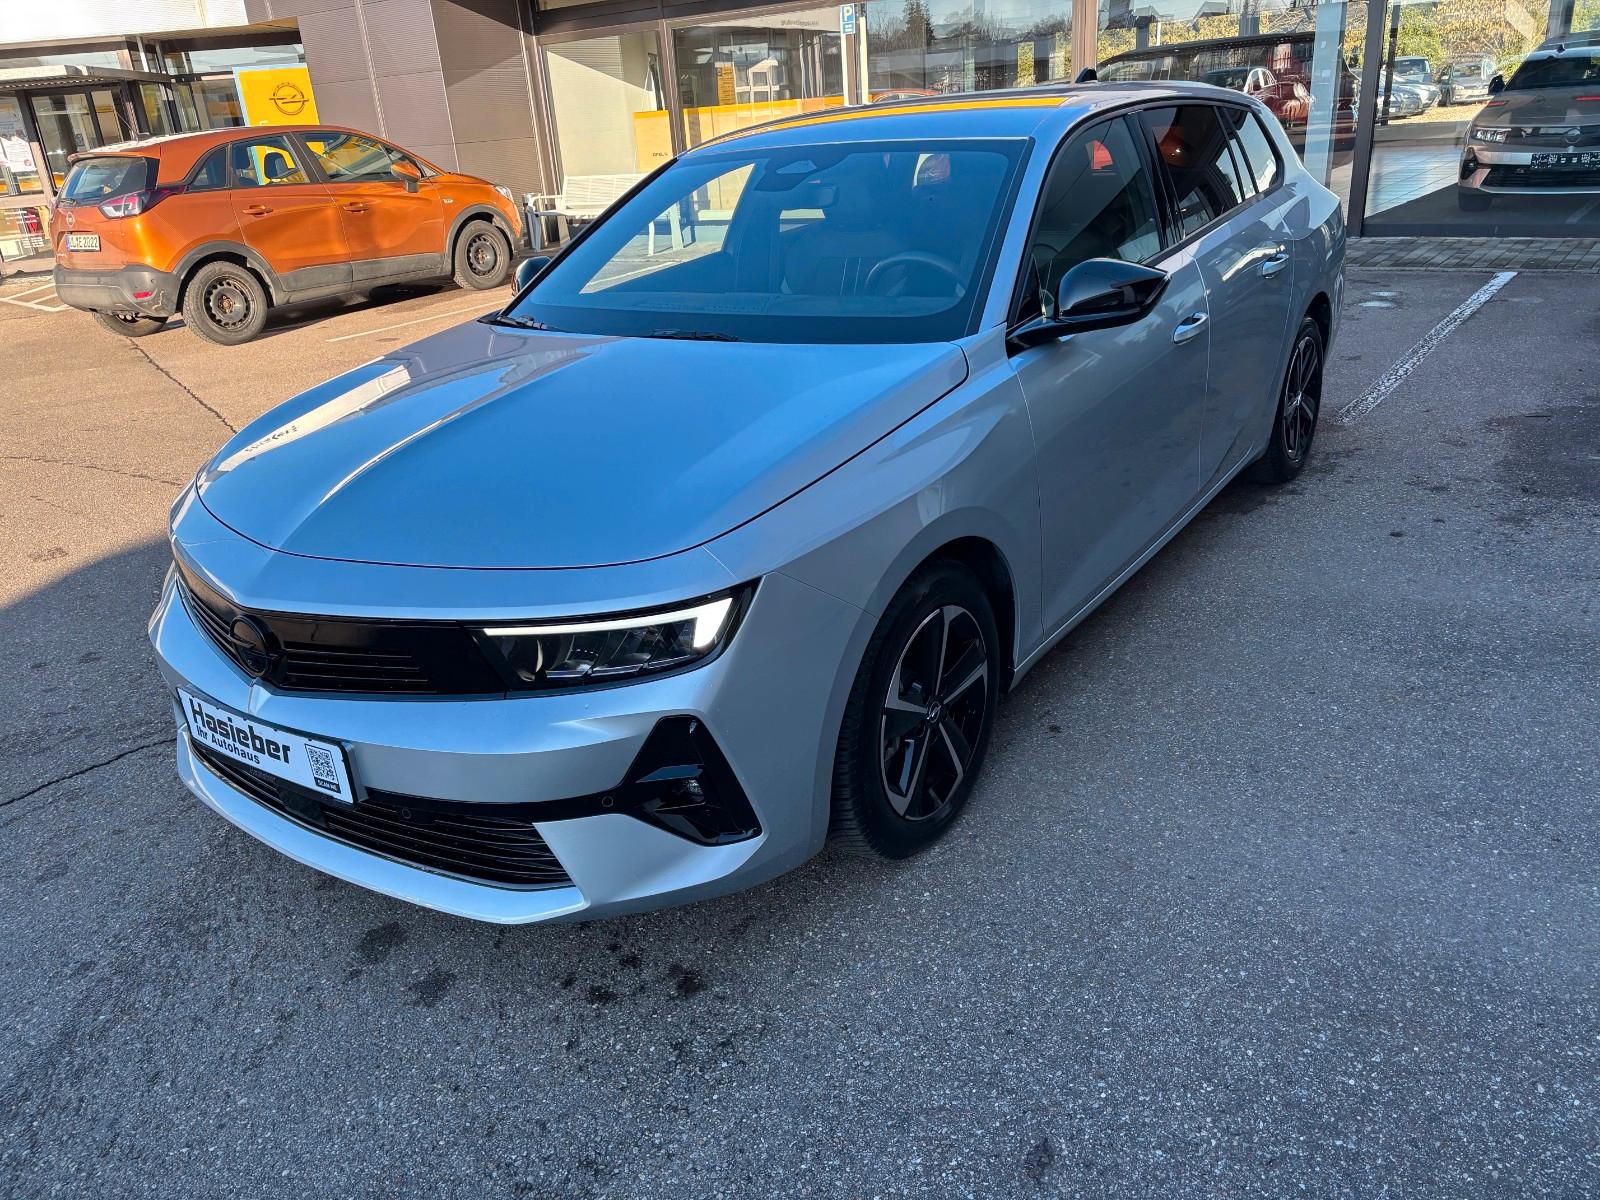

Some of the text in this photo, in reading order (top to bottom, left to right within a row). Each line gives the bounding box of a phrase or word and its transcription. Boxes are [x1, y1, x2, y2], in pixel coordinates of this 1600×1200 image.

[843, 6, 853, 22] P
[189, 697, 291, 764] Hasieber
[196, 724, 208, 740] Ihr
[211, 733, 260, 765] Autohaus
